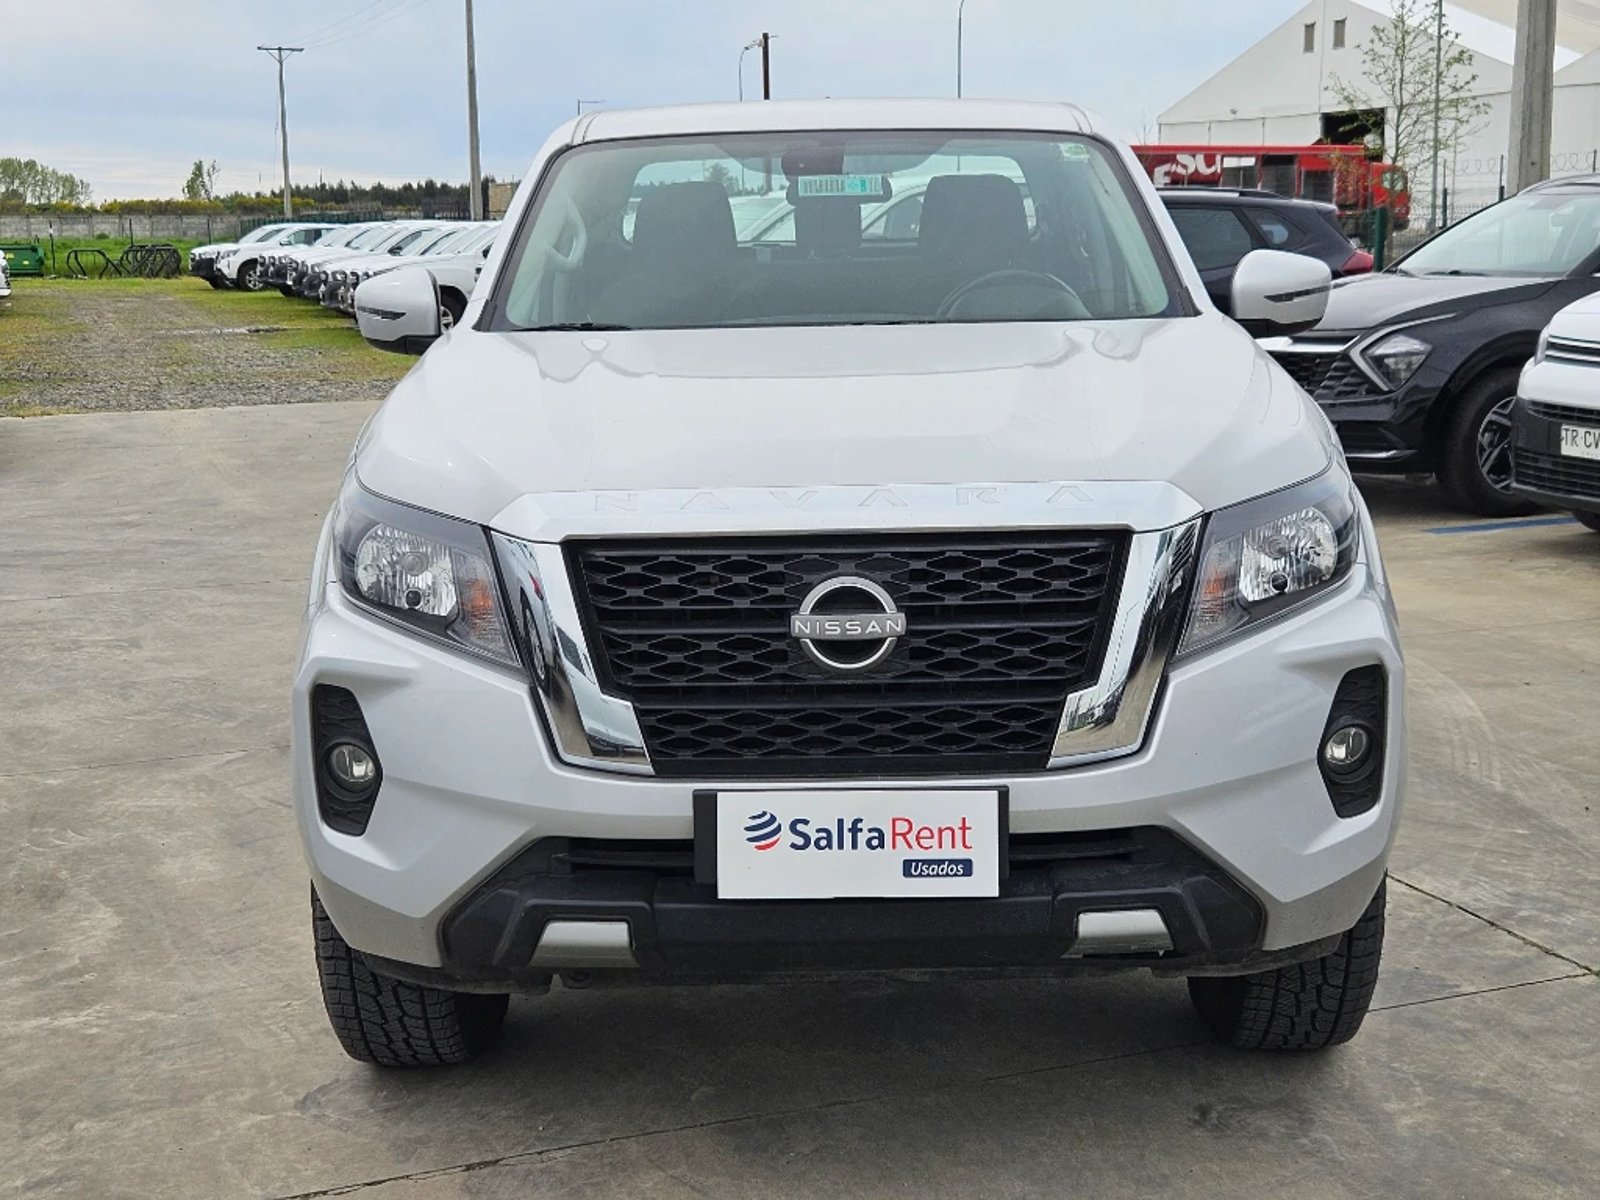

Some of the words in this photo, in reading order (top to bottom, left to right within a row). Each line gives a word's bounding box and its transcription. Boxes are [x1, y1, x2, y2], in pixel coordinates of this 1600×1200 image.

[594, 485, 1096, 512] NAVARA
[794, 619, 902, 635] NISSAN
[788, 816, 974, 851] SalfaRent
[910, 861, 965, 877] Usados
